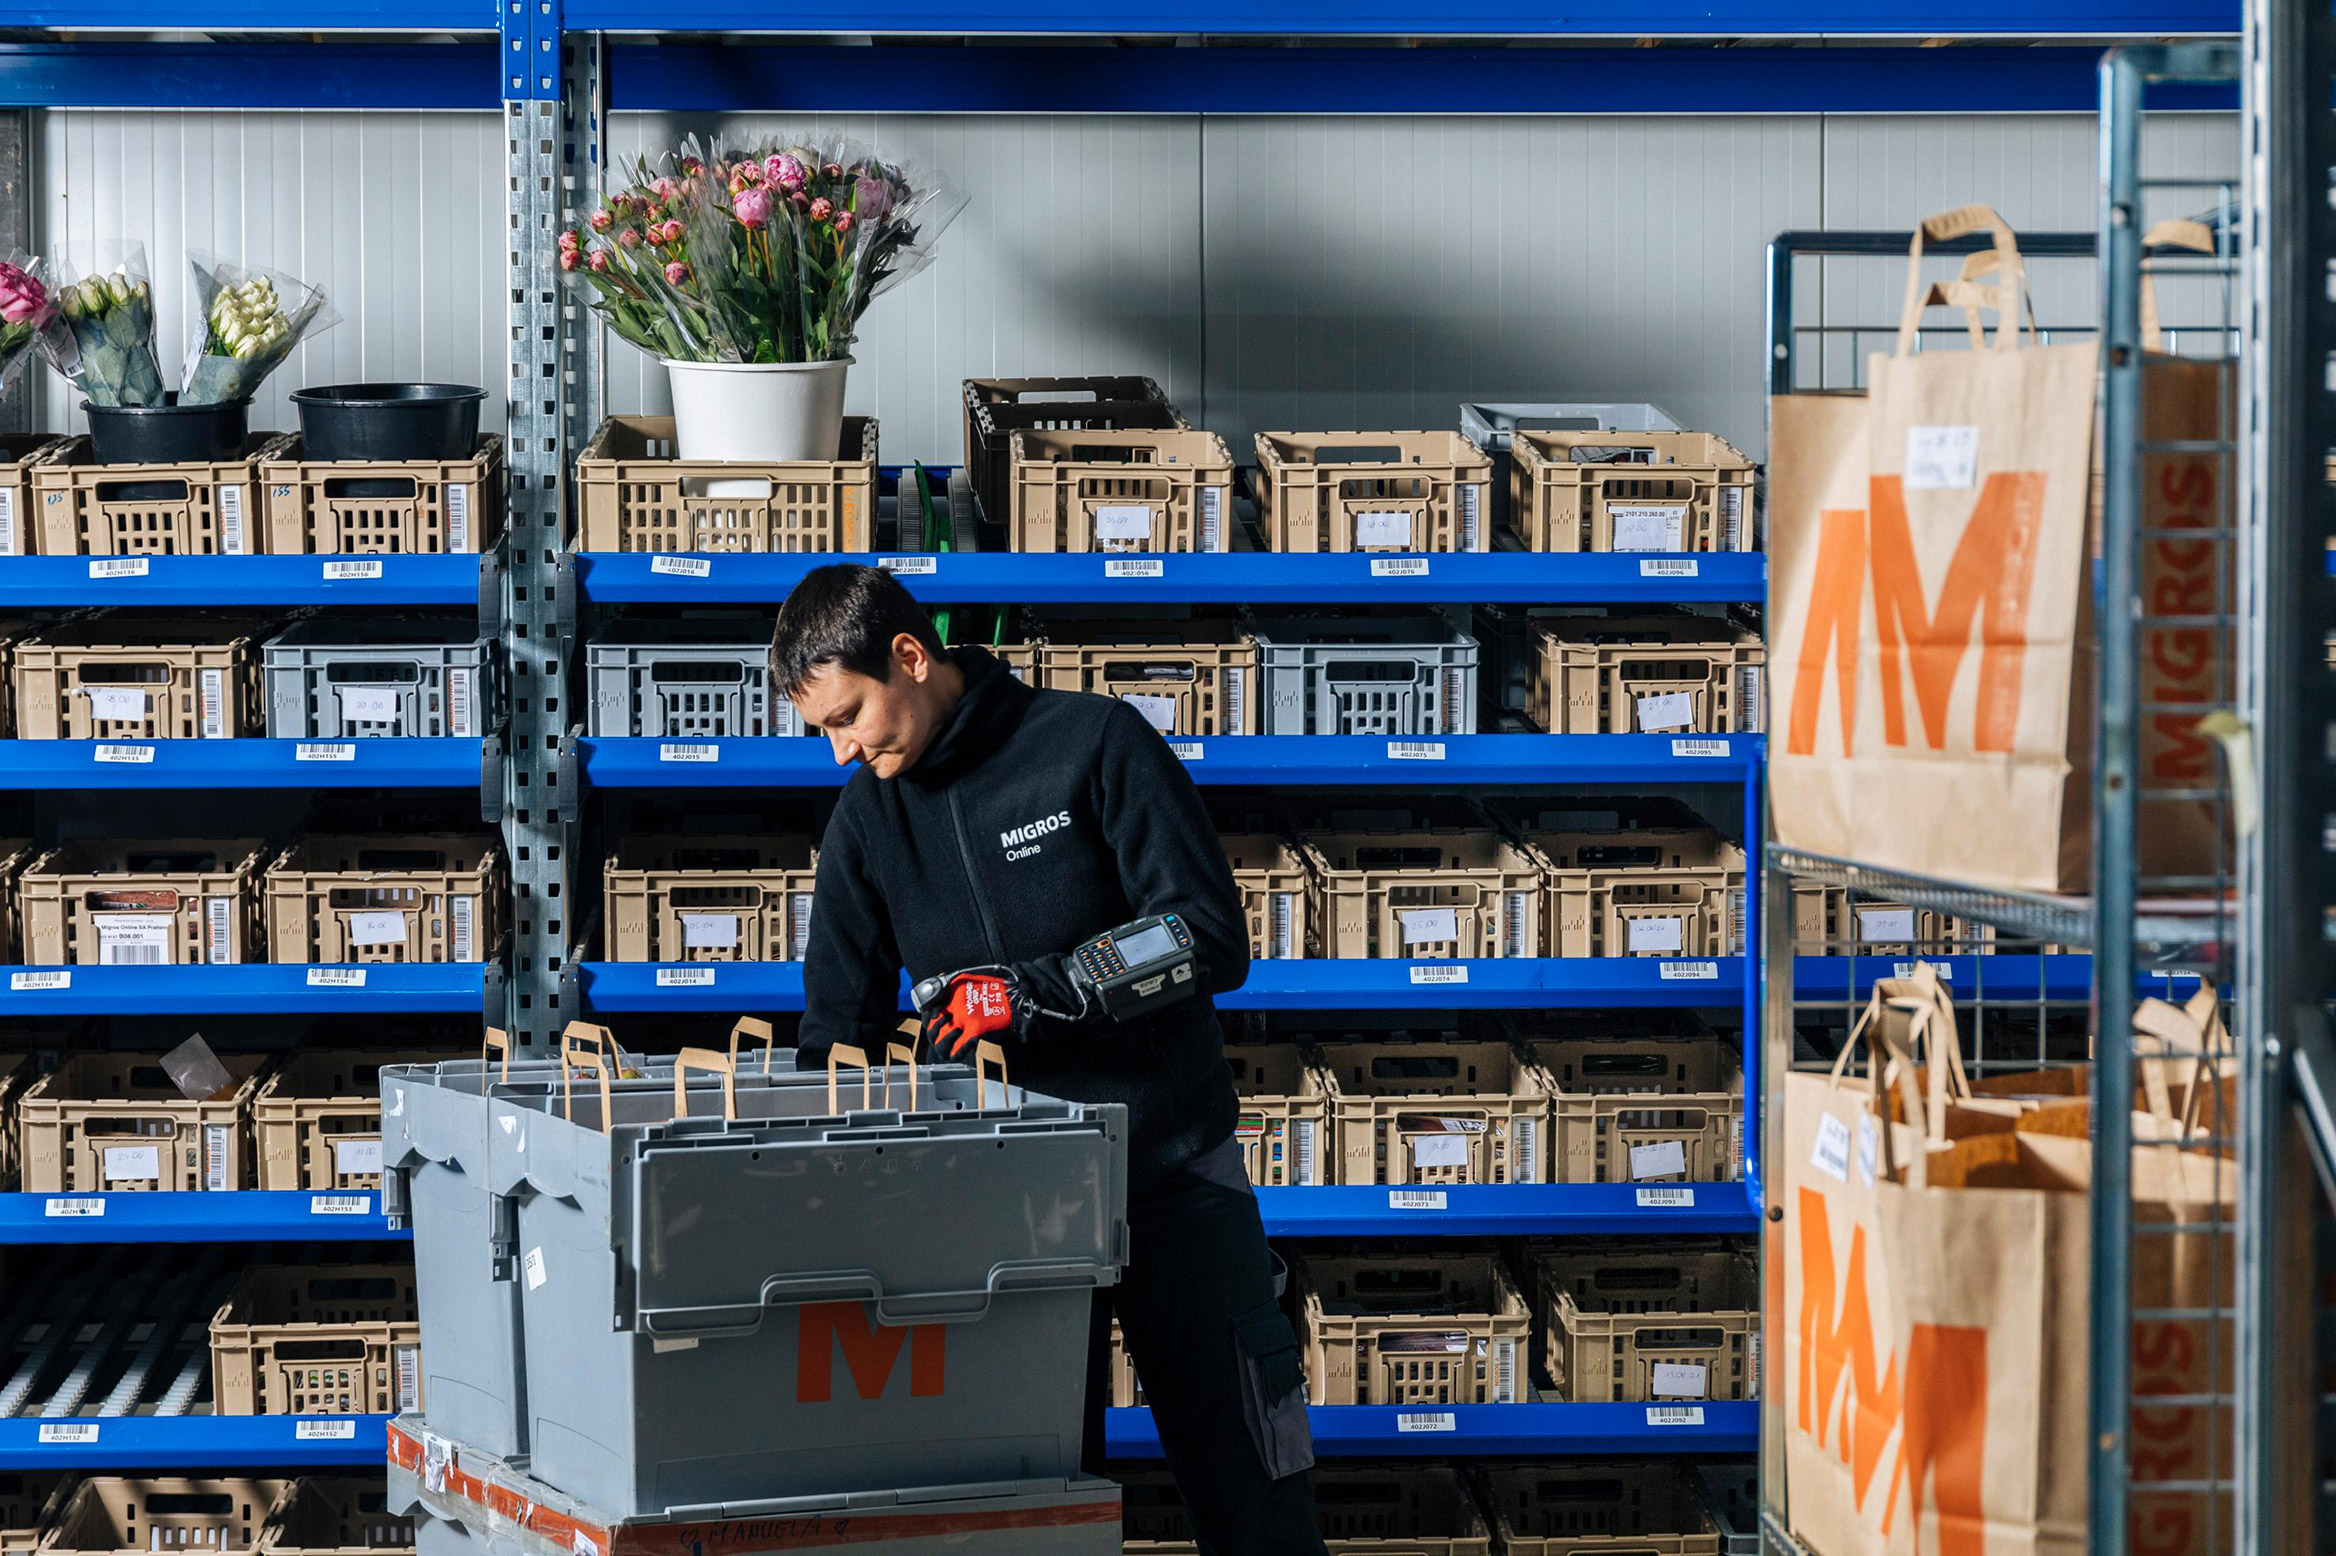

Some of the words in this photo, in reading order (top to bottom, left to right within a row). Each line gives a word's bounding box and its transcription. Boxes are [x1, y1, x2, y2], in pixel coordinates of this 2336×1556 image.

[1869, 470, 2049, 753] M
[2152, 462, 2216, 780] MIGROS
[1000, 810, 1072, 848] MIGROS
[1006, 844, 1041, 862] Online
[797, 1300, 947, 1403] M
